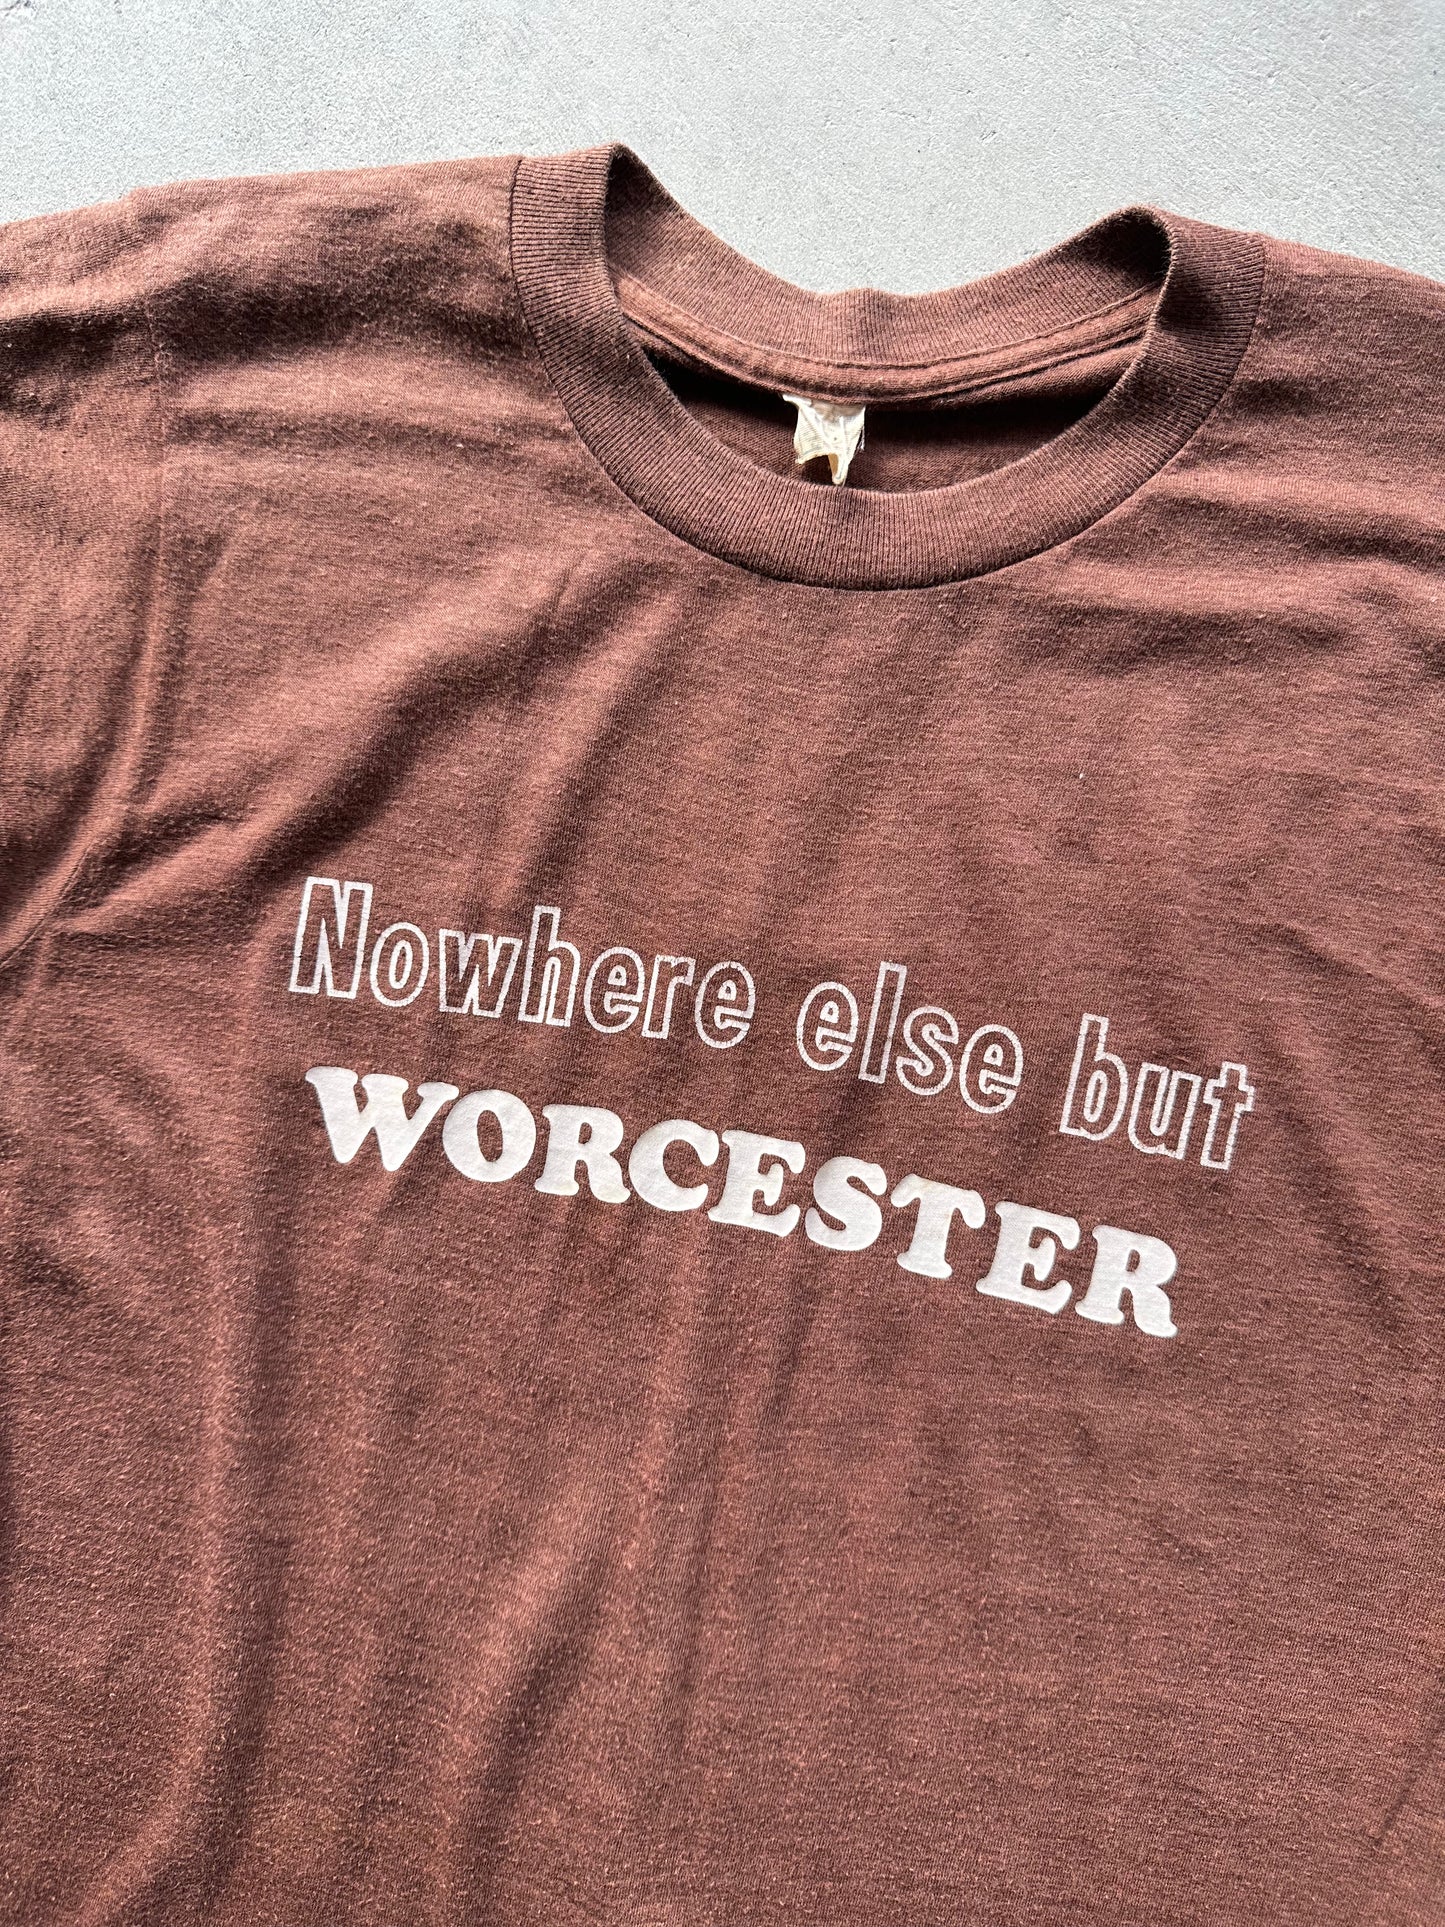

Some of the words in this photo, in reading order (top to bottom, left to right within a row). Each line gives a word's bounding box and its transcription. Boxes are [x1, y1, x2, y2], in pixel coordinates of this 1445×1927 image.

[288, 877, 756, 1049] Nowhere
[797, 961, 1024, 1114] else
[1059, 1014, 1255, 1170] but
[305, 1066, 1178, 1338] WORCESTER
